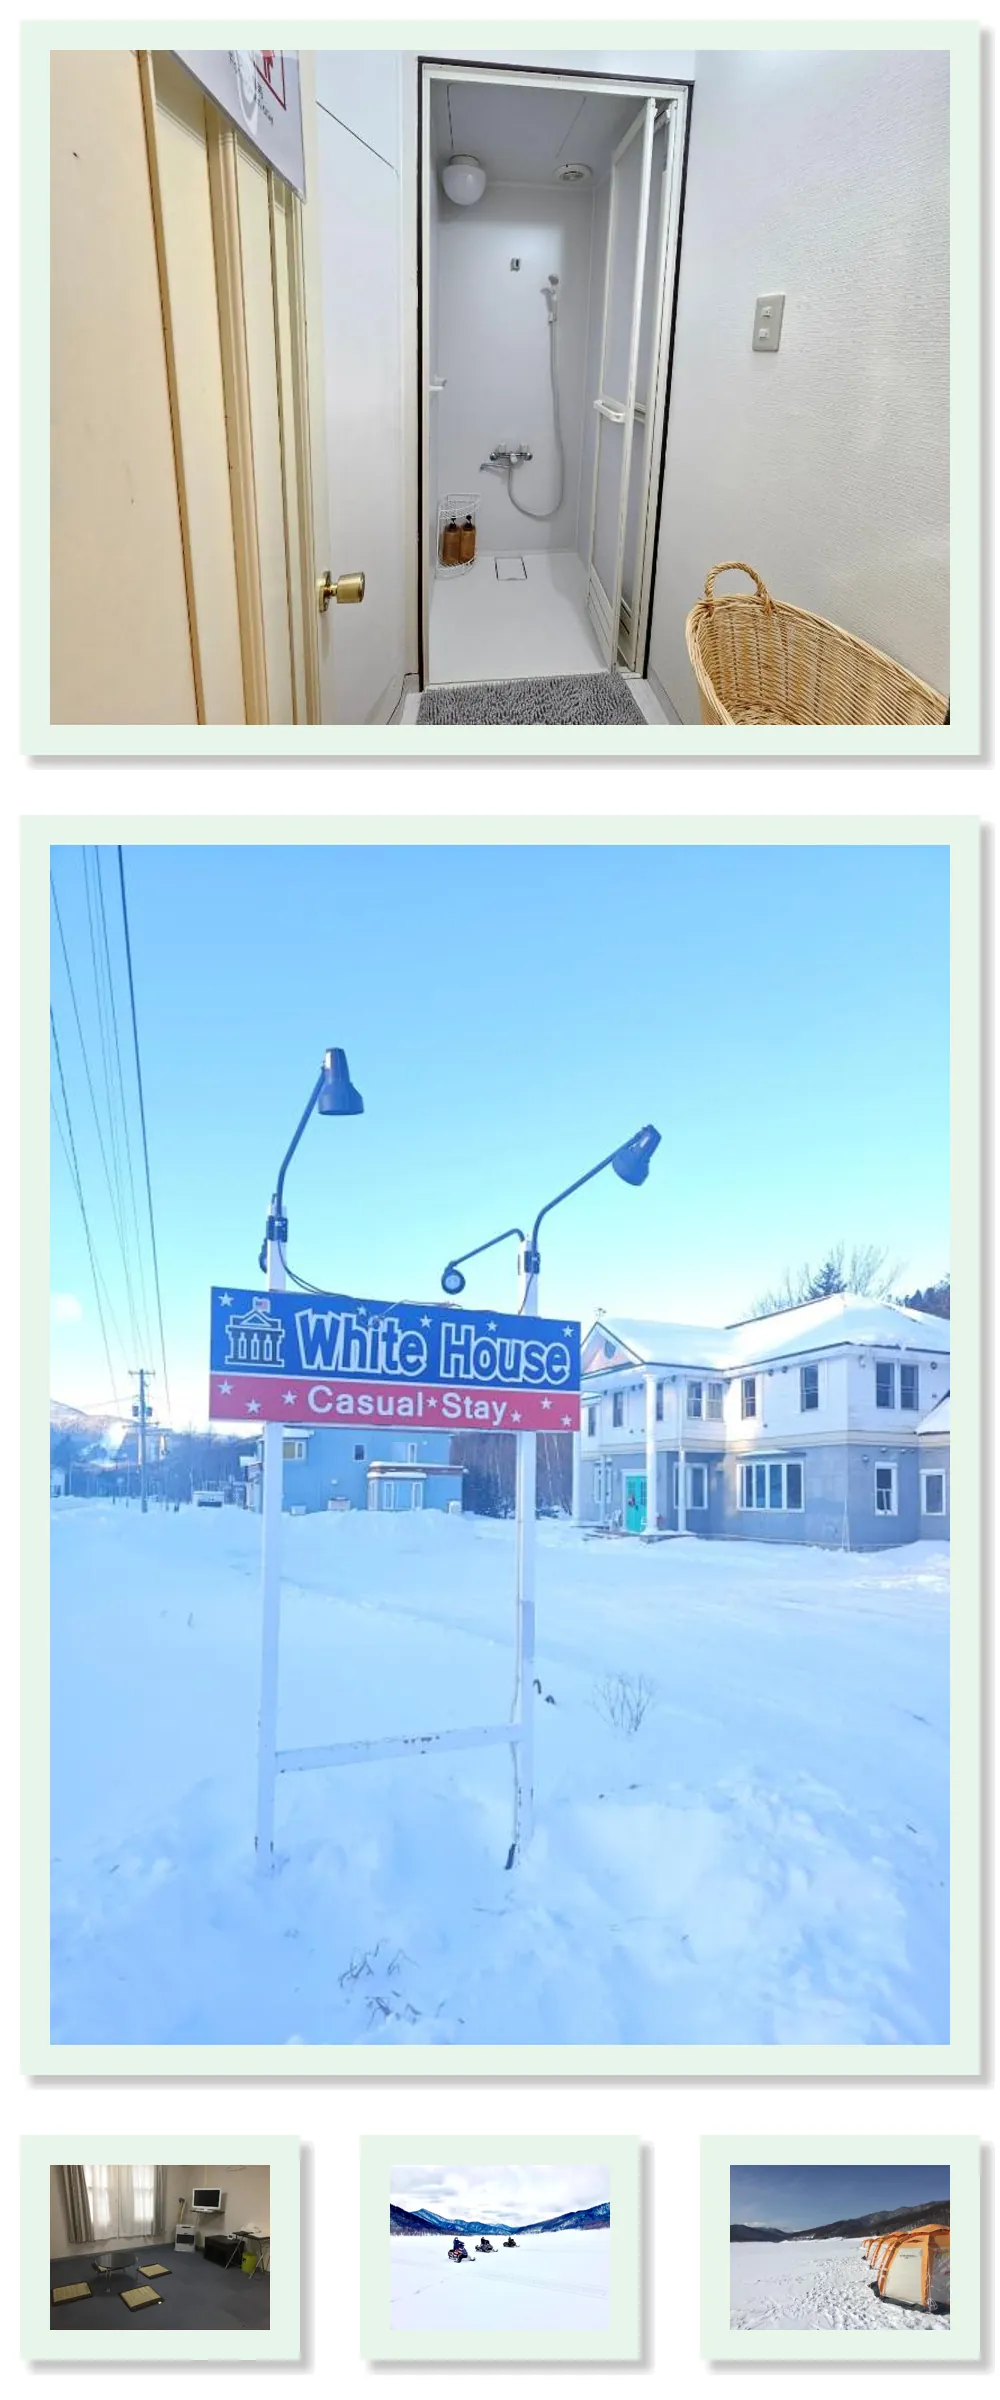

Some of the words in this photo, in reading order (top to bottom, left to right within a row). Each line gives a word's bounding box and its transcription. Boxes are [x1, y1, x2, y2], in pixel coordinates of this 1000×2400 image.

[295, 1309, 427, 1376] White
[439, 1322, 571, 1384] House
[307, 1385, 423, 1417] Casual
[441, 1393, 507, 1426] Stay
